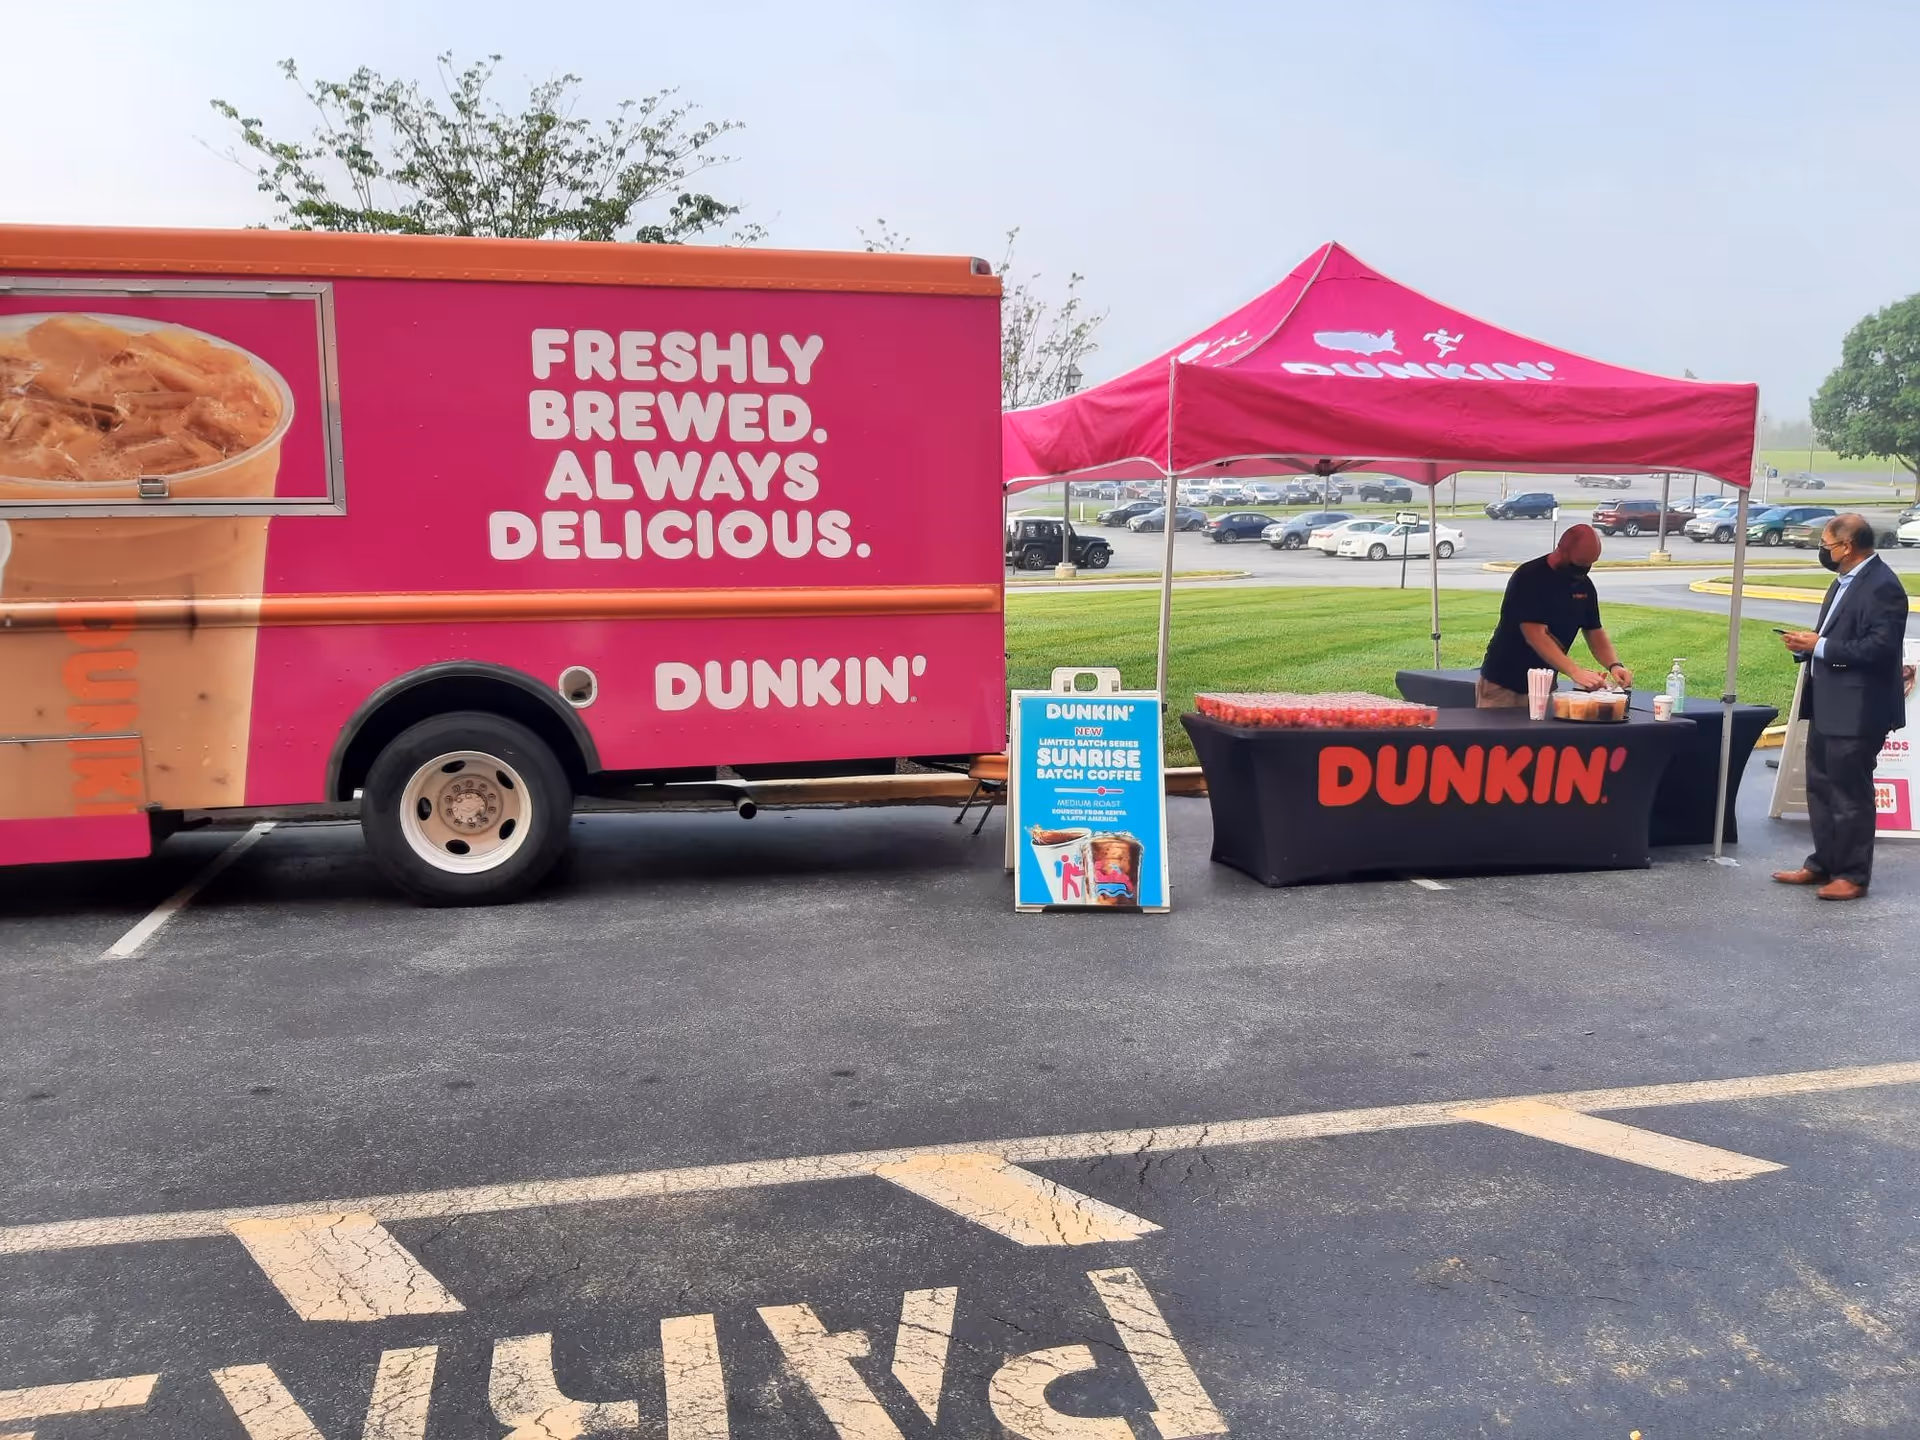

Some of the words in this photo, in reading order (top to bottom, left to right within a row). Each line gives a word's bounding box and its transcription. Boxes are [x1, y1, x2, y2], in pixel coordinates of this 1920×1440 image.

[531, 328, 824, 384] FRESHLY
[1280, 361, 1555, 381] DUNKIN'
[529, 390, 828, 443] BREWED.
[545, 450, 819, 501] ALWAYS
[489, 509, 871, 560] DELICIOUS.
[654, 655, 927, 711] DUNKIN'
[1046, 703, 1135, 721] DUNKIN'
[1075, 727, 1103, 737] NEW
[1039, 738, 1075, 747] LIMITED
[1077, 739, 1107, 747] BATCH
[1109, 740, 1139, 748] SERIES
[1036, 747, 1142, 768] SUNRISE
[1036, 768, 1084, 780] BATCH
[1087, 769, 1142, 781] COFFEE
[1317, 744, 1628, 806] DUNKIN'
[1057, 799, 1092, 808] MEDIUM
[1093, 800, 1121, 808] ROAST
